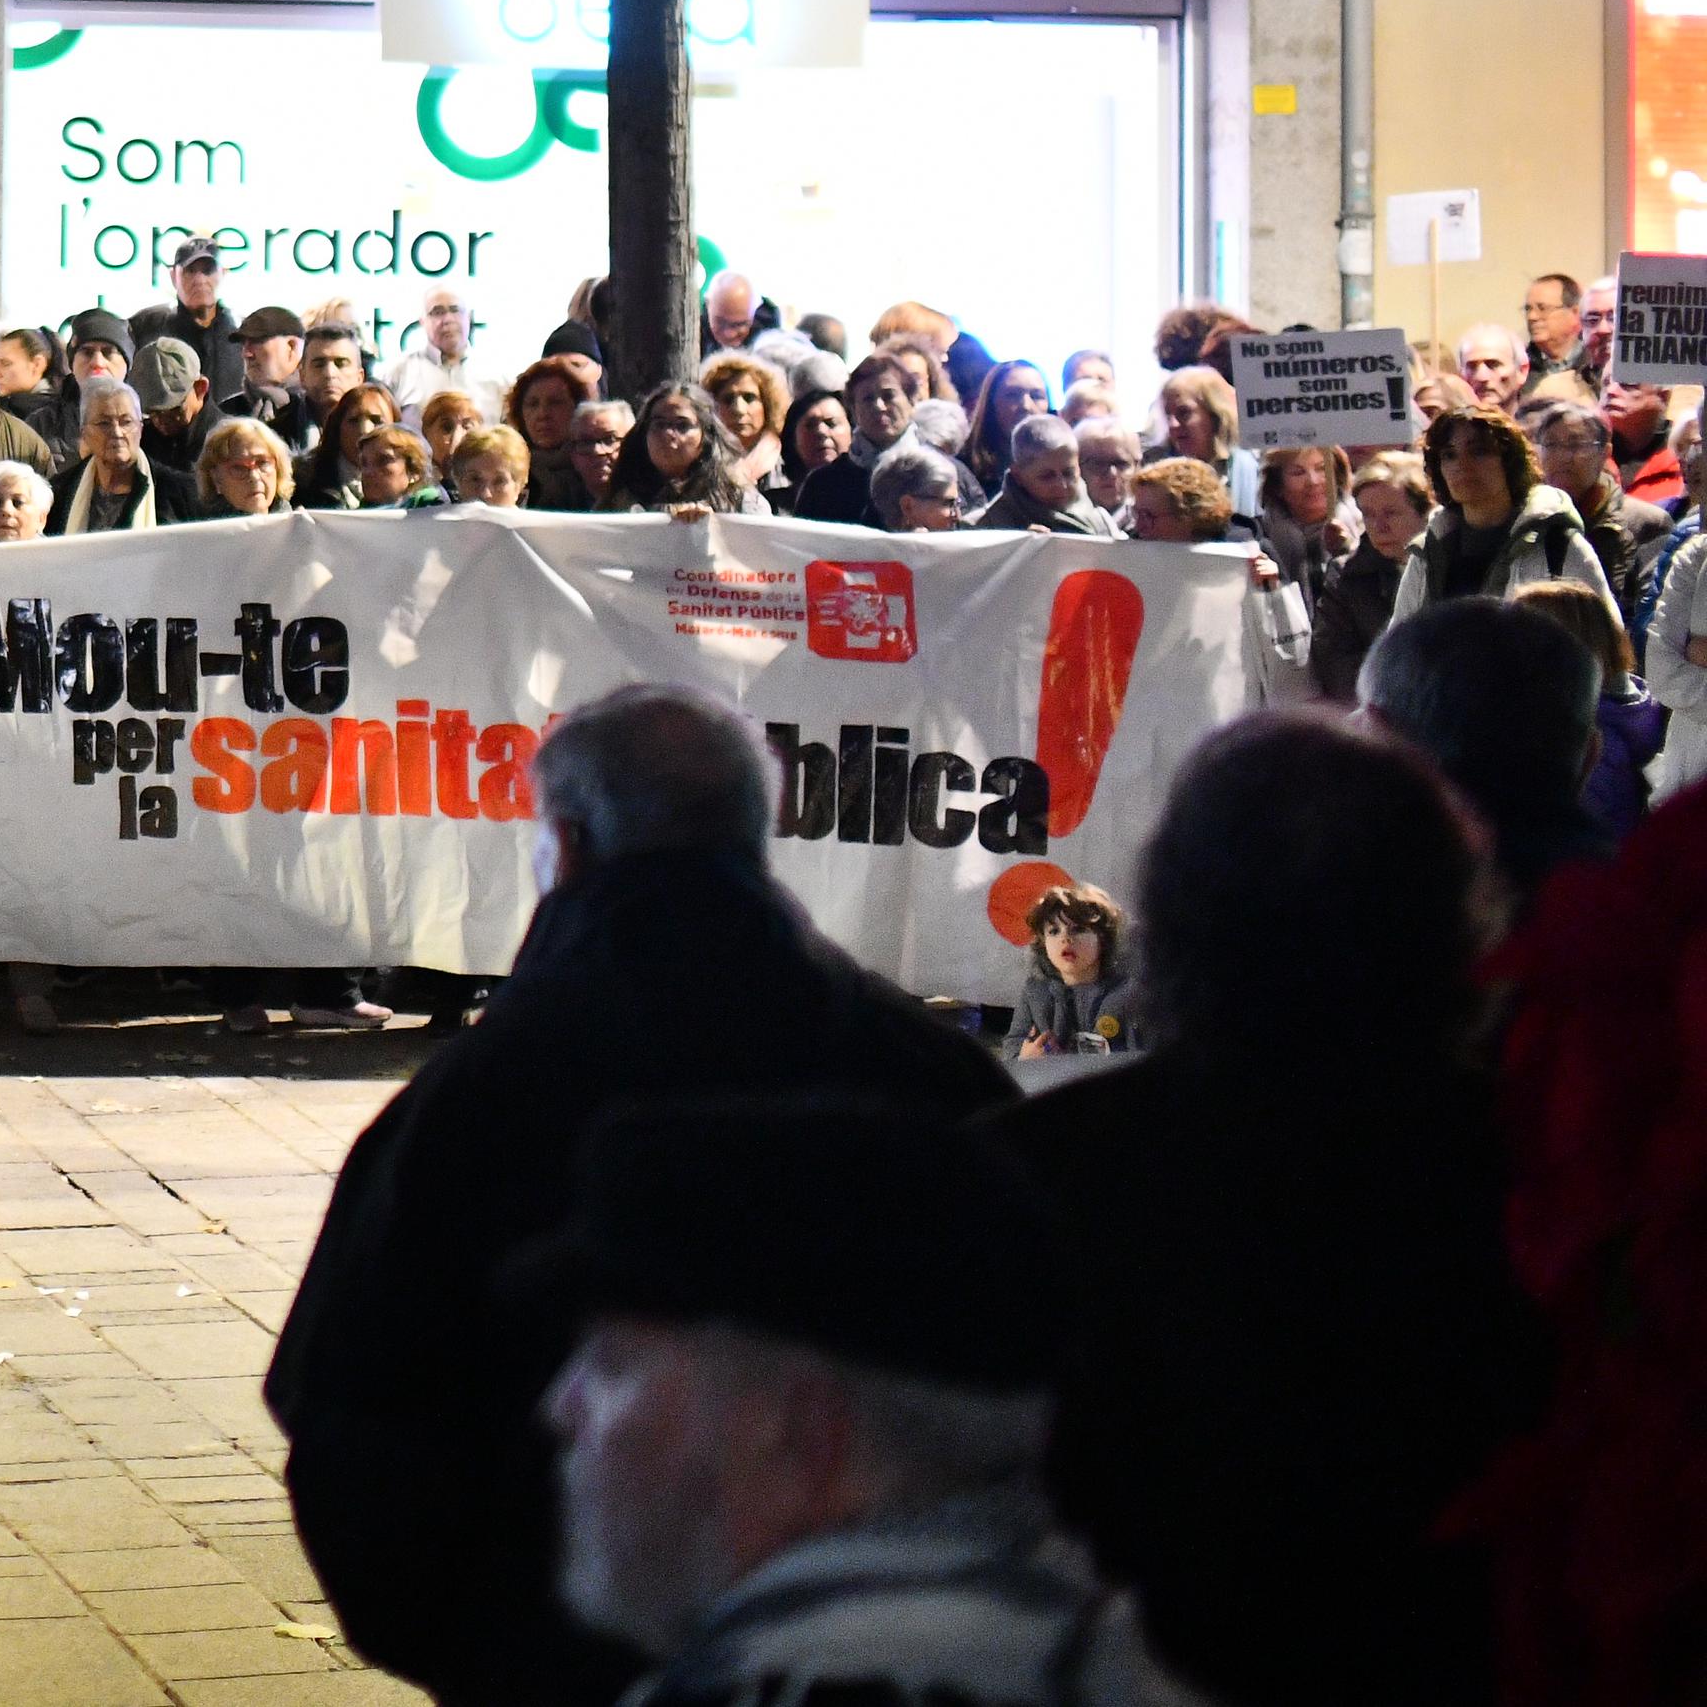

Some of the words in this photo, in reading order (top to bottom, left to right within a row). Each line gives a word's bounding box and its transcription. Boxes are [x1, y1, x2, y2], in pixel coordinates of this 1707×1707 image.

[60, 116, 246, 185] Som
[1620, 306, 1645, 333] la
[1241, 343, 1270, 358] No
[1274, 341, 1324, 356] som
[1246, 377, 1406, 421] persones!
[1298, 378, 1347, 393] som
[73, 717, 185, 785] per
[190, 699, 572, 822] sanita
[118, 775, 178, 840] la
